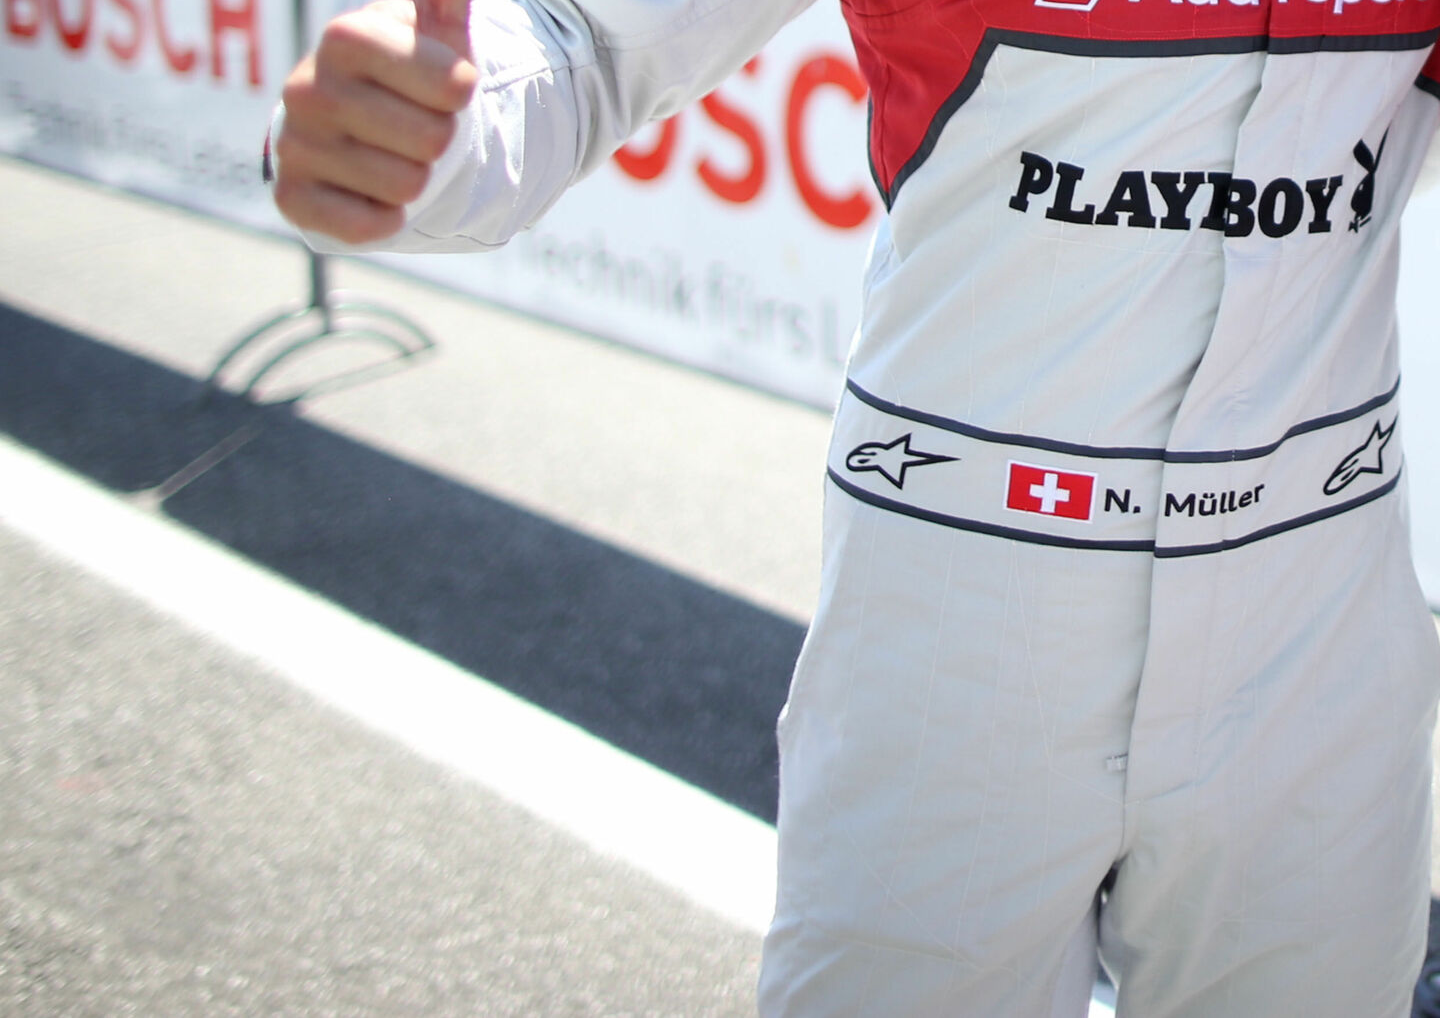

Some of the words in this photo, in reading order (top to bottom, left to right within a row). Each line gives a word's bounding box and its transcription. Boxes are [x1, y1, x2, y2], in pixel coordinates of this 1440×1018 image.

[1008, 150, 1344, 239] PLAYBOY
[1104, 488, 1142, 514] N.
[1164, 484, 1265, 518] Müller
